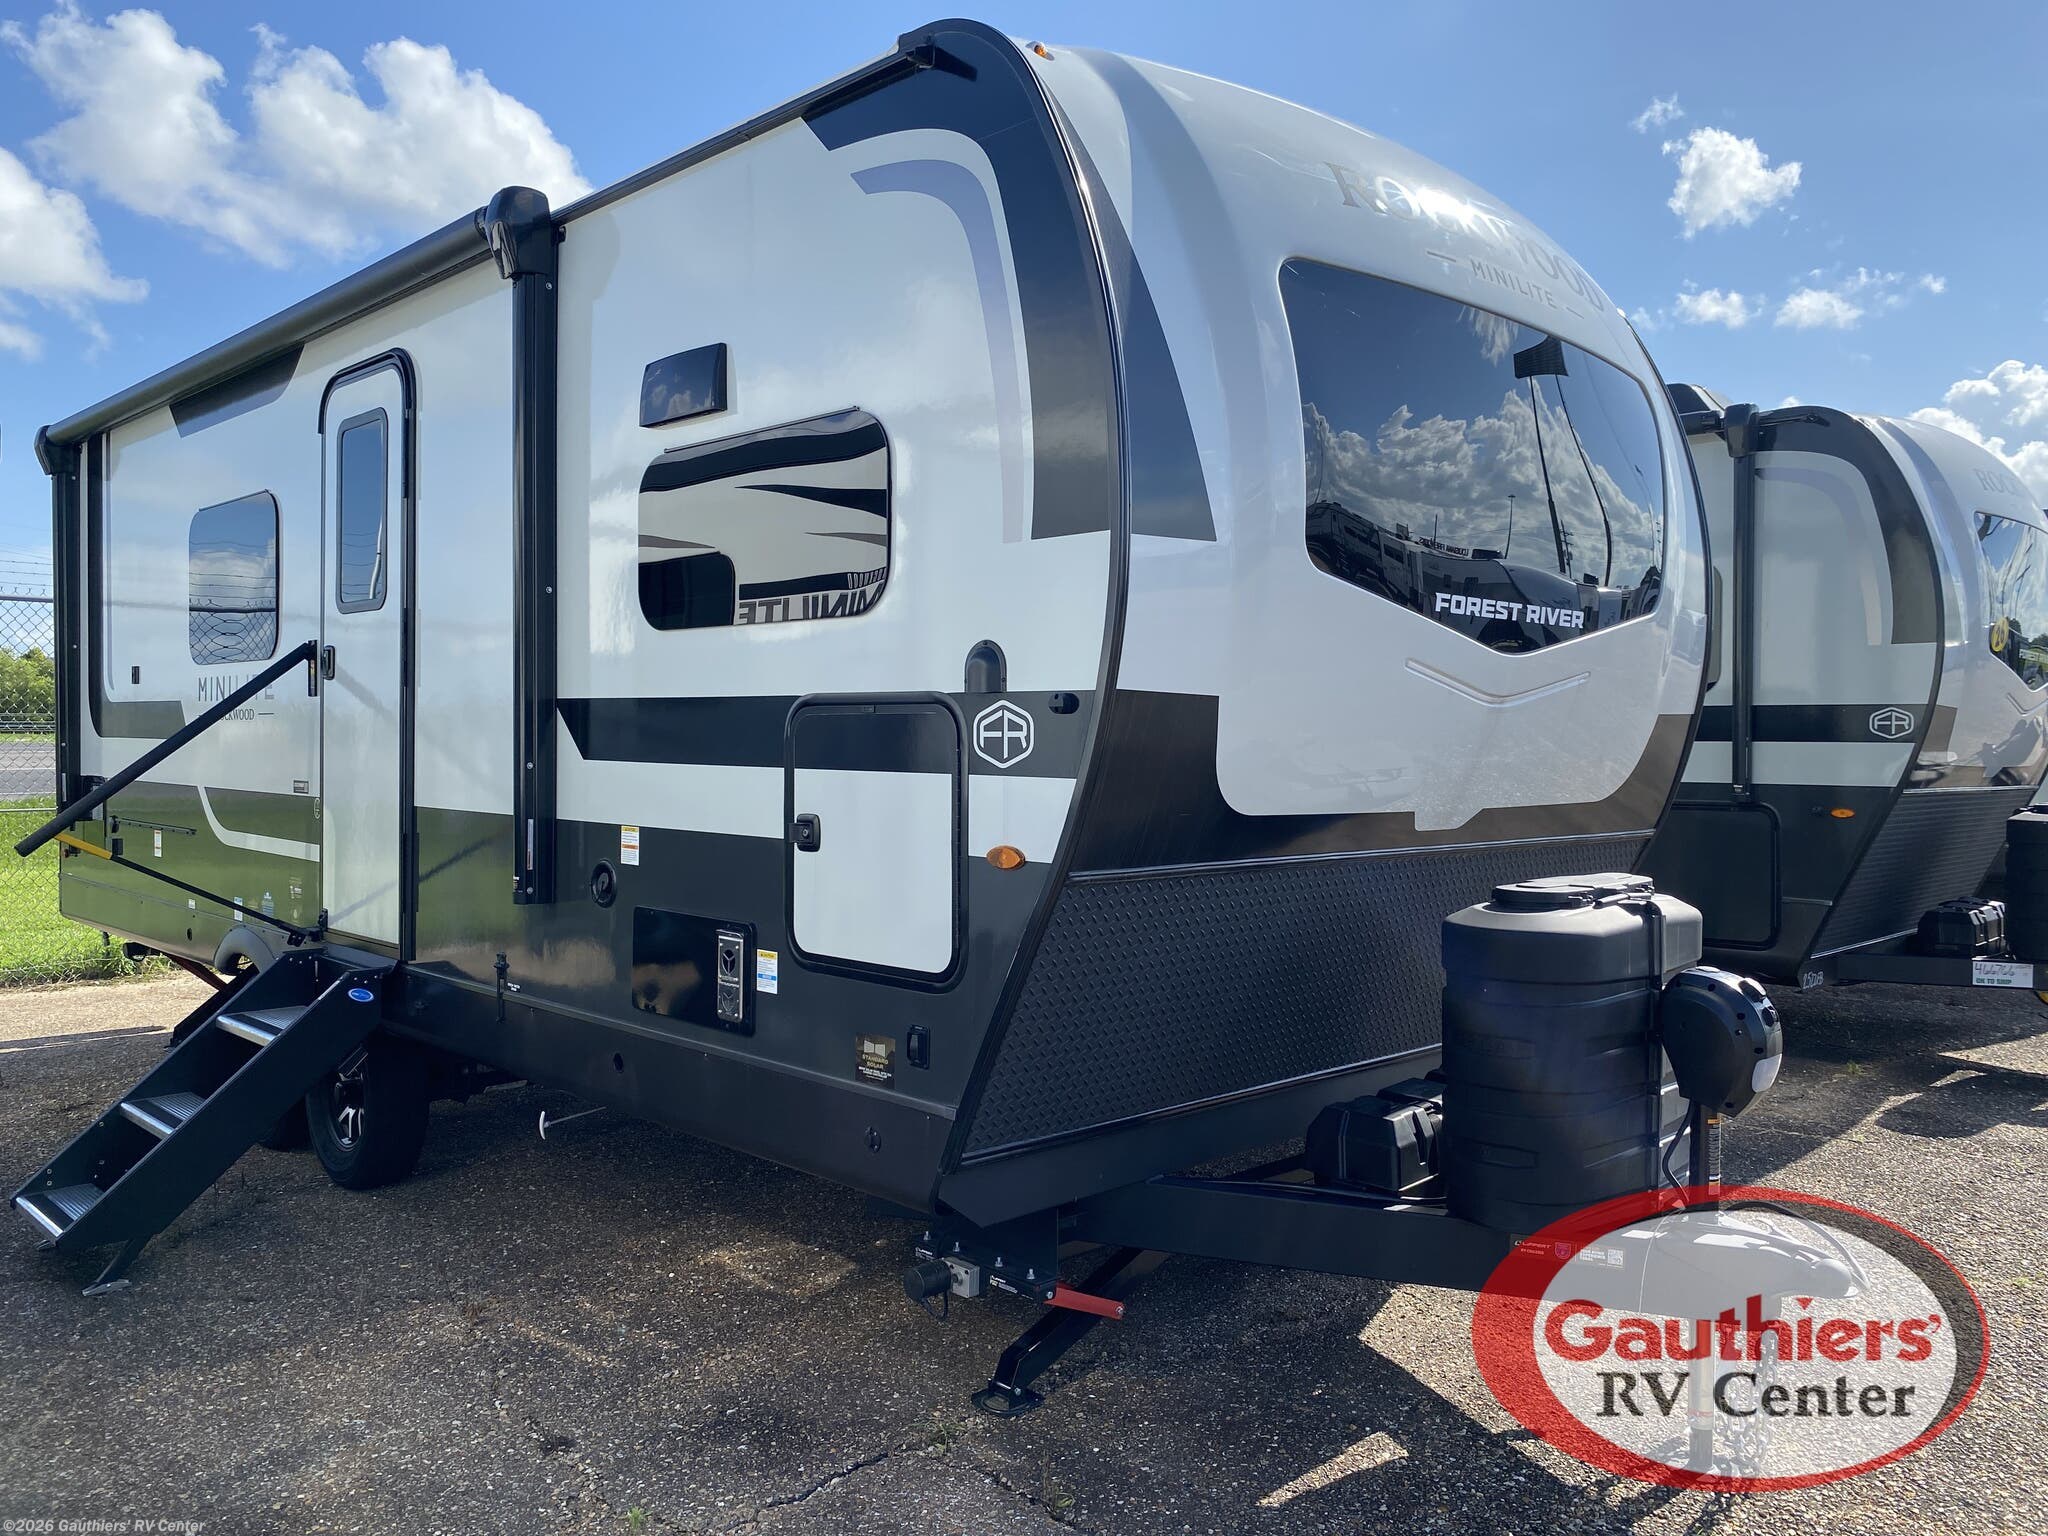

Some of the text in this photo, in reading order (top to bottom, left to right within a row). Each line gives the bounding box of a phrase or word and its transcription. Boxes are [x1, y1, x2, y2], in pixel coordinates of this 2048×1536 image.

[1470, 258, 1558, 310] MINILITE
[1434, 592, 1585, 629] FOREST RIVER
[198, 674, 275, 702] MINIE
